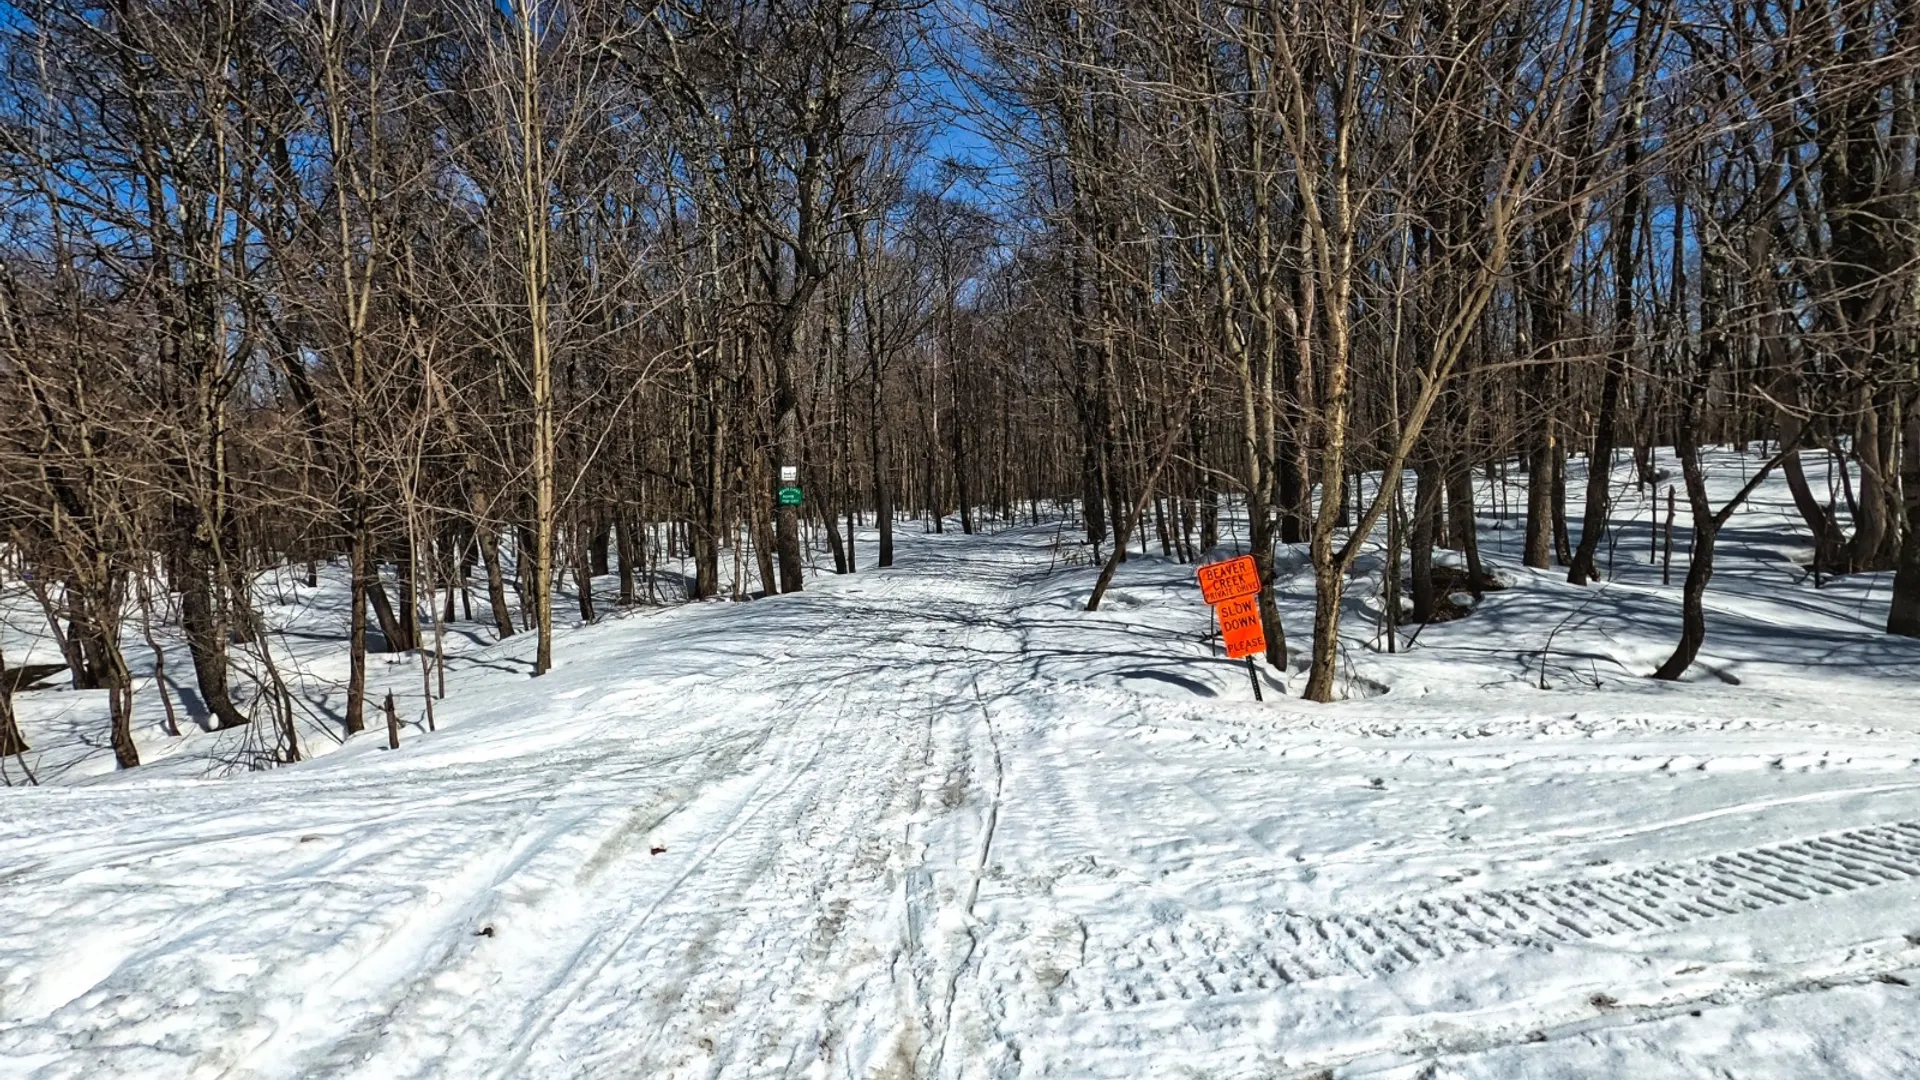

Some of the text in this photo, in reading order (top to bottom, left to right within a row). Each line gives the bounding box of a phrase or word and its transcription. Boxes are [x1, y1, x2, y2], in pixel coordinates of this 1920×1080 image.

[1207, 562, 1246, 580] BEAVER
[1213, 574, 1246, 590] CREEK
[1205, 583, 1258, 601] PRIVATE DRIVE
[1221, 600, 1252, 618] SLOW
[1224, 615, 1257, 632] DOWN
[1228, 637, 1264, 652] PLEASE
